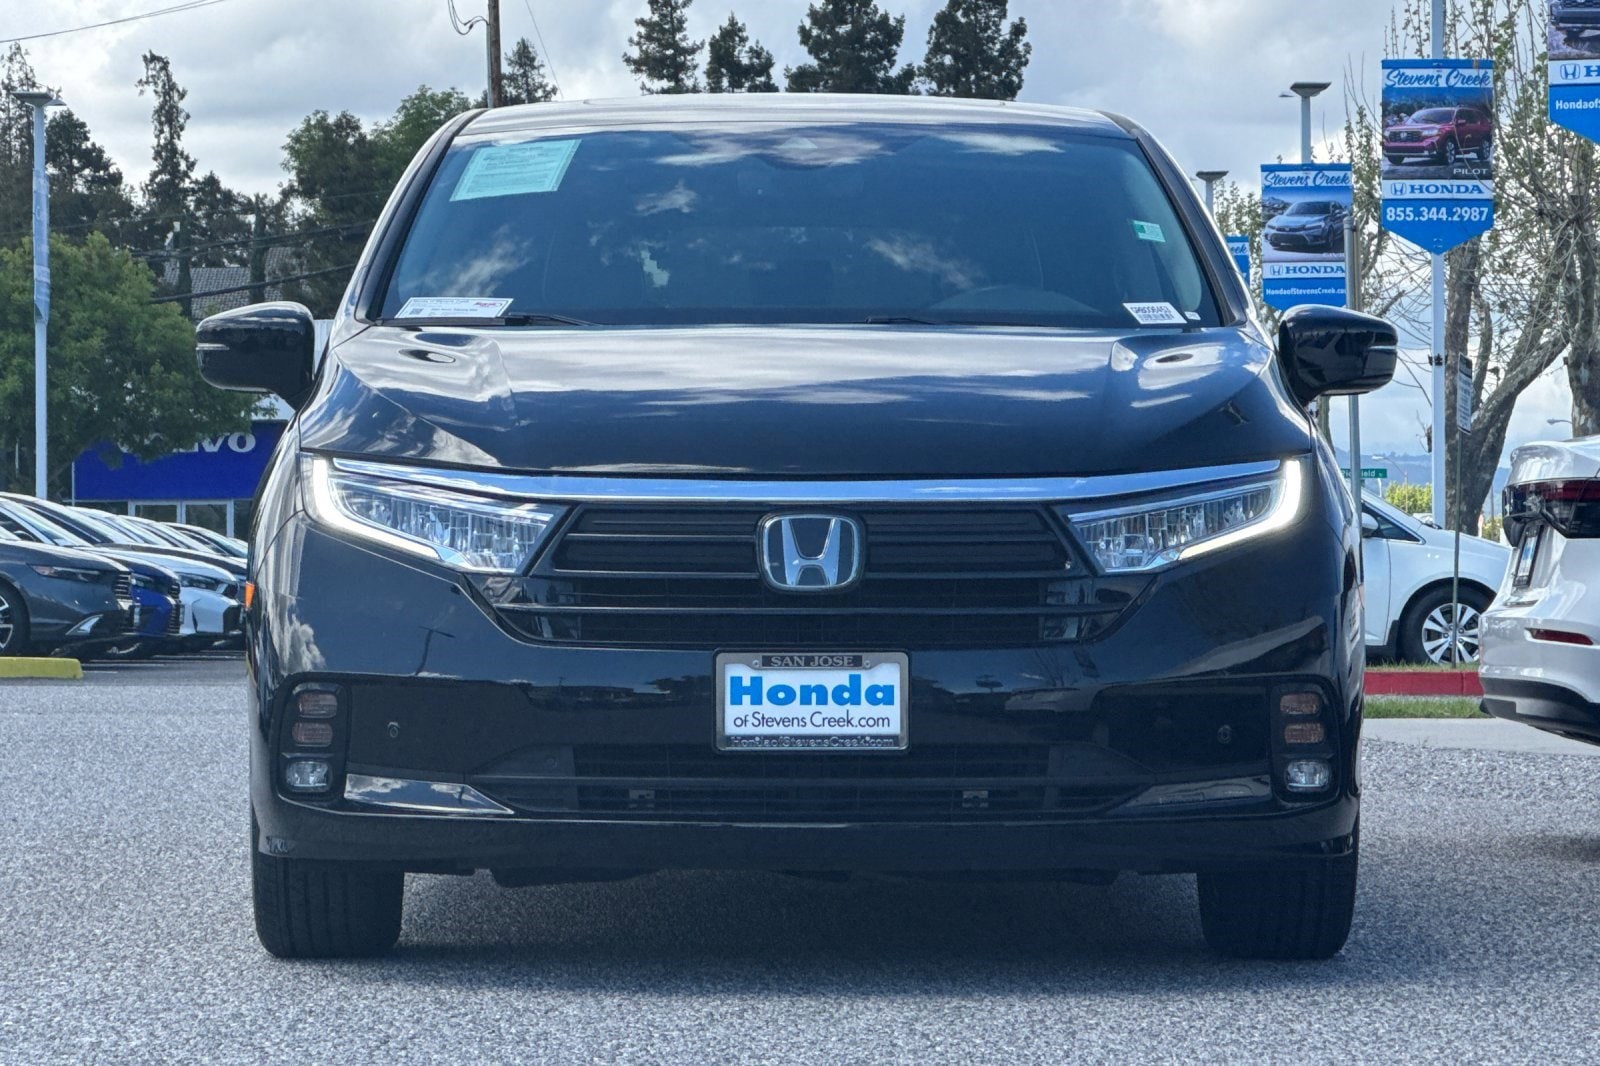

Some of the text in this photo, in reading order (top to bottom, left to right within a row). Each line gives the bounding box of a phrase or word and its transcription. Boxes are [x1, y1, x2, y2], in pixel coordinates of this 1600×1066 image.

[1385, 67, 1492, 87] Stevens Creek
[1555, 98, 1600, 110] Hondaof
[1264, 170, 1349, 187] Stevens Creek
[1409, 184, 1485, 194] HONDA
[1386, 206, 1489, 222] 855.344.2987
[1285, 265, 1346, 275] HONDA
[1266, 287, 1346, 296] HondaofStevensCreek.co
[771, 656, 854, 667] SAN JOSE
[730, 674, 895, 706] Honda
[733, 709, 890, 728] of Stevens Creek.com
[730, 736, 894, 747] HondaofStevensCreek.com
